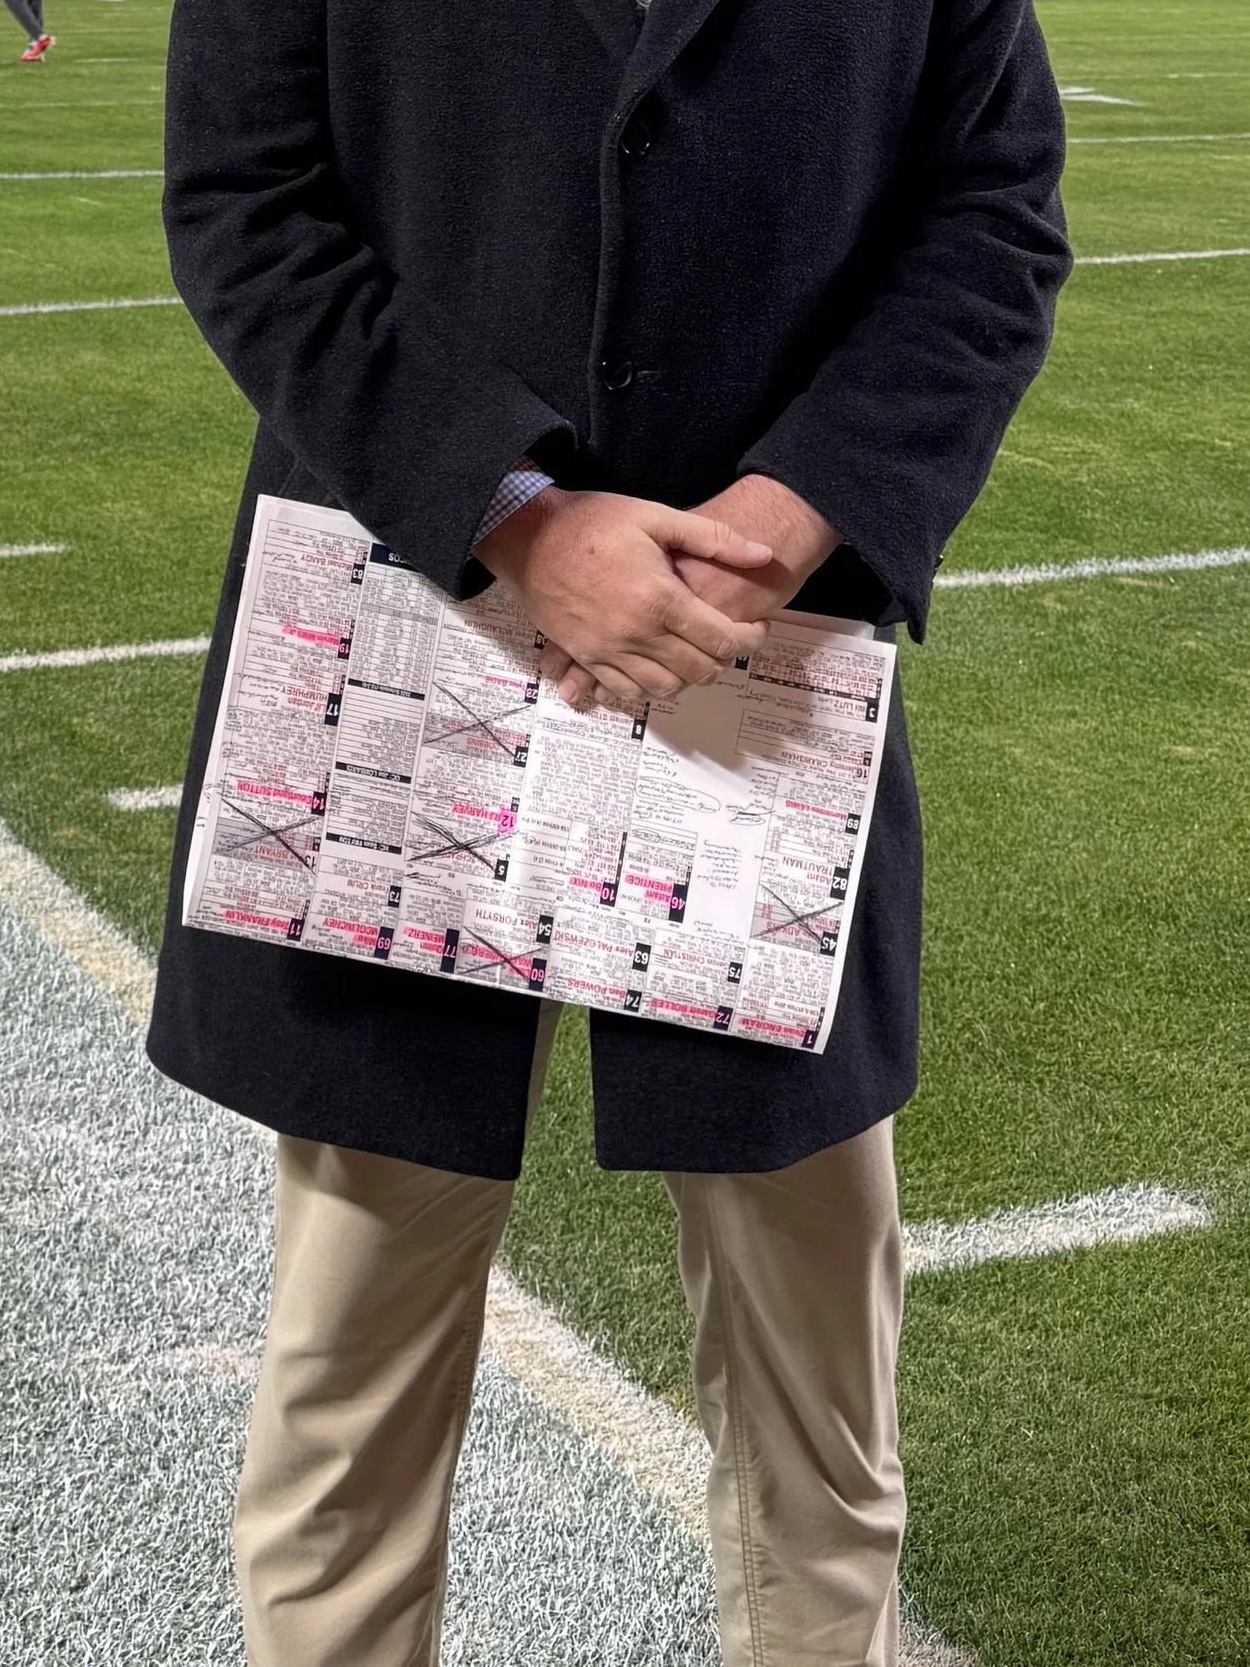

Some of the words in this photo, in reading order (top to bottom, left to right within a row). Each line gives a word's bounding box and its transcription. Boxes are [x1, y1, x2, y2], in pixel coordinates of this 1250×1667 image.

[300, 552, 326, 566] BANDY
[326, 558, 353, 571] Michael
[351, 567, 364, 579] 83
[338, 642, 350, 653] 19
[280, 683, 328, 703] HUMPHREY
[325, 701, 340, 717] 17
[832, 699, 854, 710] LUTZ
[867, 706, 877, 718] 3
[634, 723, 643, 735] 8
[514, 749, 527, 762] 27
[855, 767, 868, 779] 16
[312, 796, 326, 810] 14
[451, 802, 488, 819] HARVEY
[499, 813, 516, 828] 12
[845, 817, 859, 830] 89
[253, 843, 290, 860] BRYANT
[302, 853, 317, 869] 13
[781, 855, 834, 875] TRAUTMAN
[496, 863, 506, 875] 5
[623, 873, 673, 893] PRENTICE
[805, 871, 832, 885] Adam
[831, 875, 848, 890] 82
[588, 880, 602, 891] Bo
[388, 890, 401, 903] 73
[600, 886, 616, 902] 10
[644, 888, 671, 902] Adam
[669, 895, 686, 911] 46
[223, 908, 270, 927] FRANKLIN
[474, 908, 518, 926] FORSYTH
[519, 918, 537, 929] Alex
[288, 922, 302, 936] 11
[537, 921, 552, 935] 54
[376, 935, 391, 950] 69
[418, 940, 443, 953] Quinn
[819, 936, 837, 952] 45
[442, 943, 458, 958] 77
[614, 945, 634, 956] Alex
[633, 949, 650, 964] 63
[530, 967, 545, 981] 60
[727, 965, 741, 979] 75
[565, 976, 608, 995] POWERS
[607, 986, 626, 998] Ben
[624, 994, 640, 1008] 74
[714, 1011, 731, 1024] 72
[805, 1033, 814, 1044] 1
